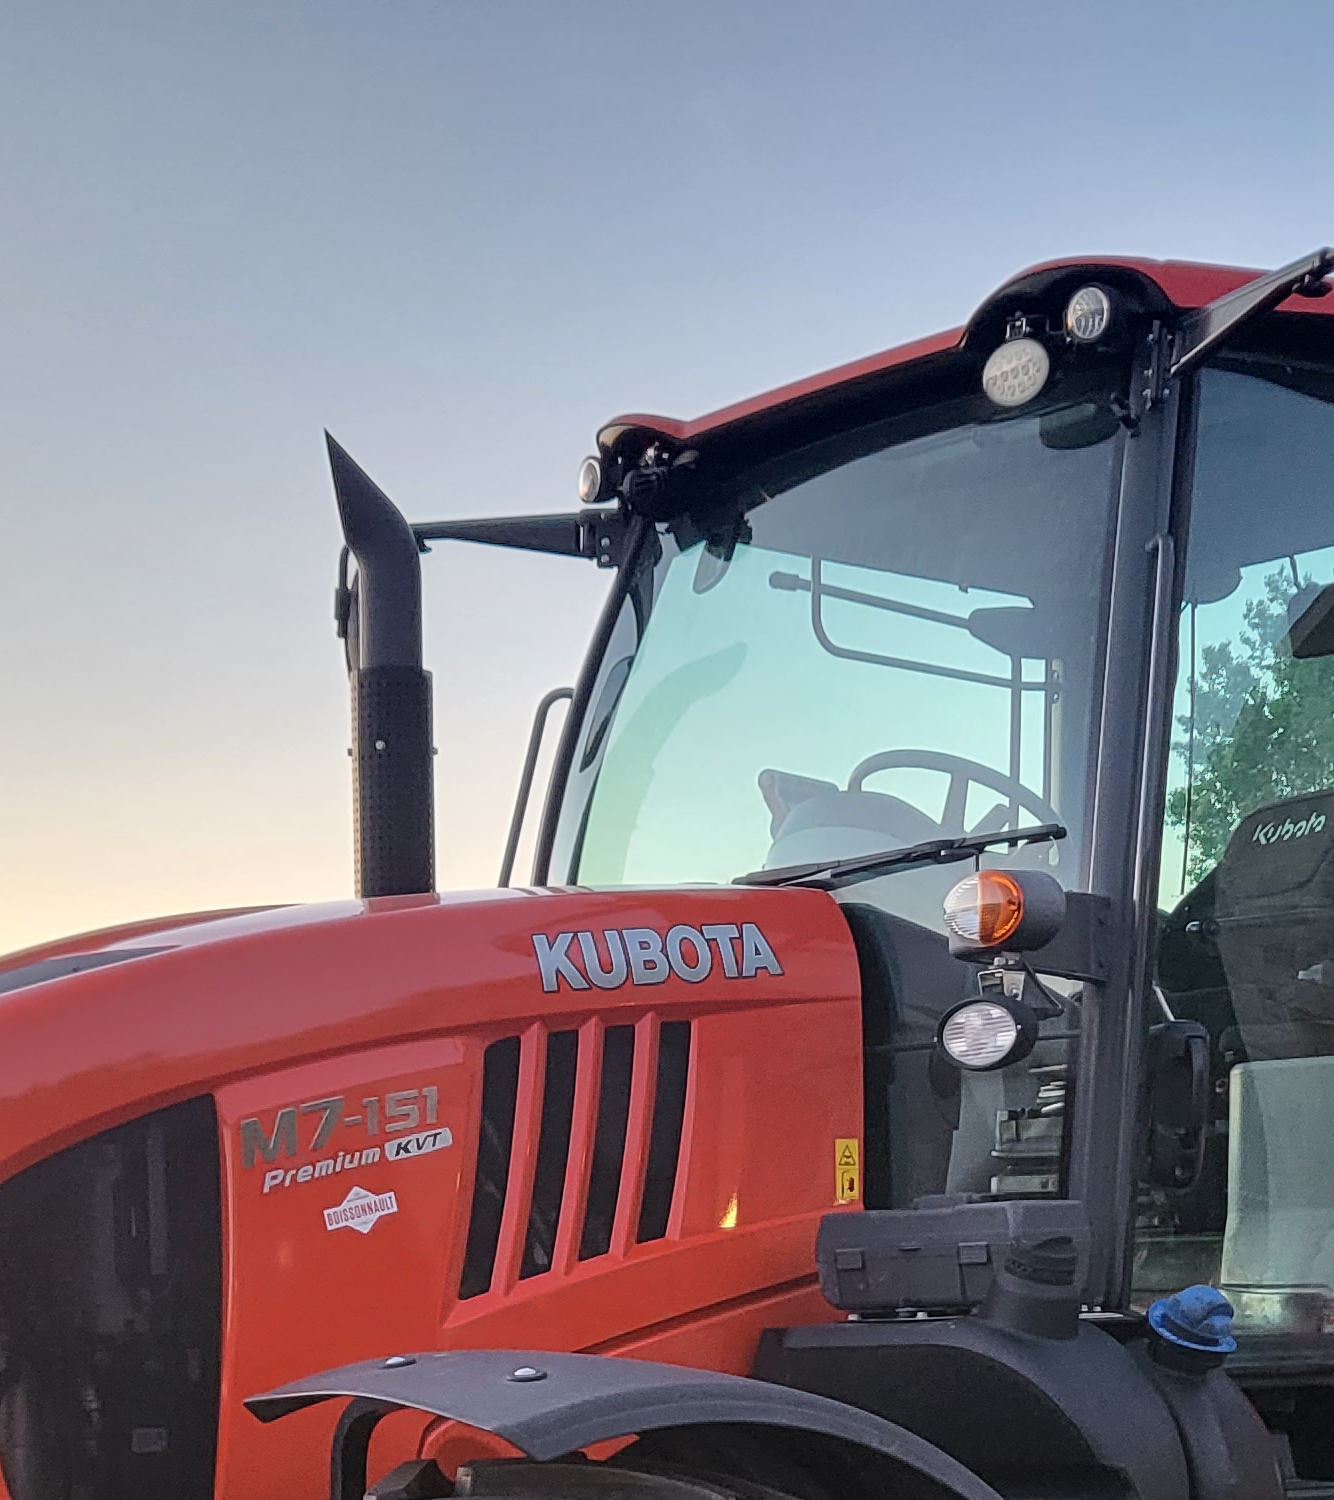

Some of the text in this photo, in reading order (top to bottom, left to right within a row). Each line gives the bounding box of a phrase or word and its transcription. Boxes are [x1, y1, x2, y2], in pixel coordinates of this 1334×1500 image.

[1252, 812, 1326, 845] Kubota
[531, 922, 784, 993] KUBOTA
[240, 1086, 438, 1169] M7-151
[262, 1131, 443, 1194] Premium KVT
[326, 1196, 394, 1226] BOISSONNAULT
